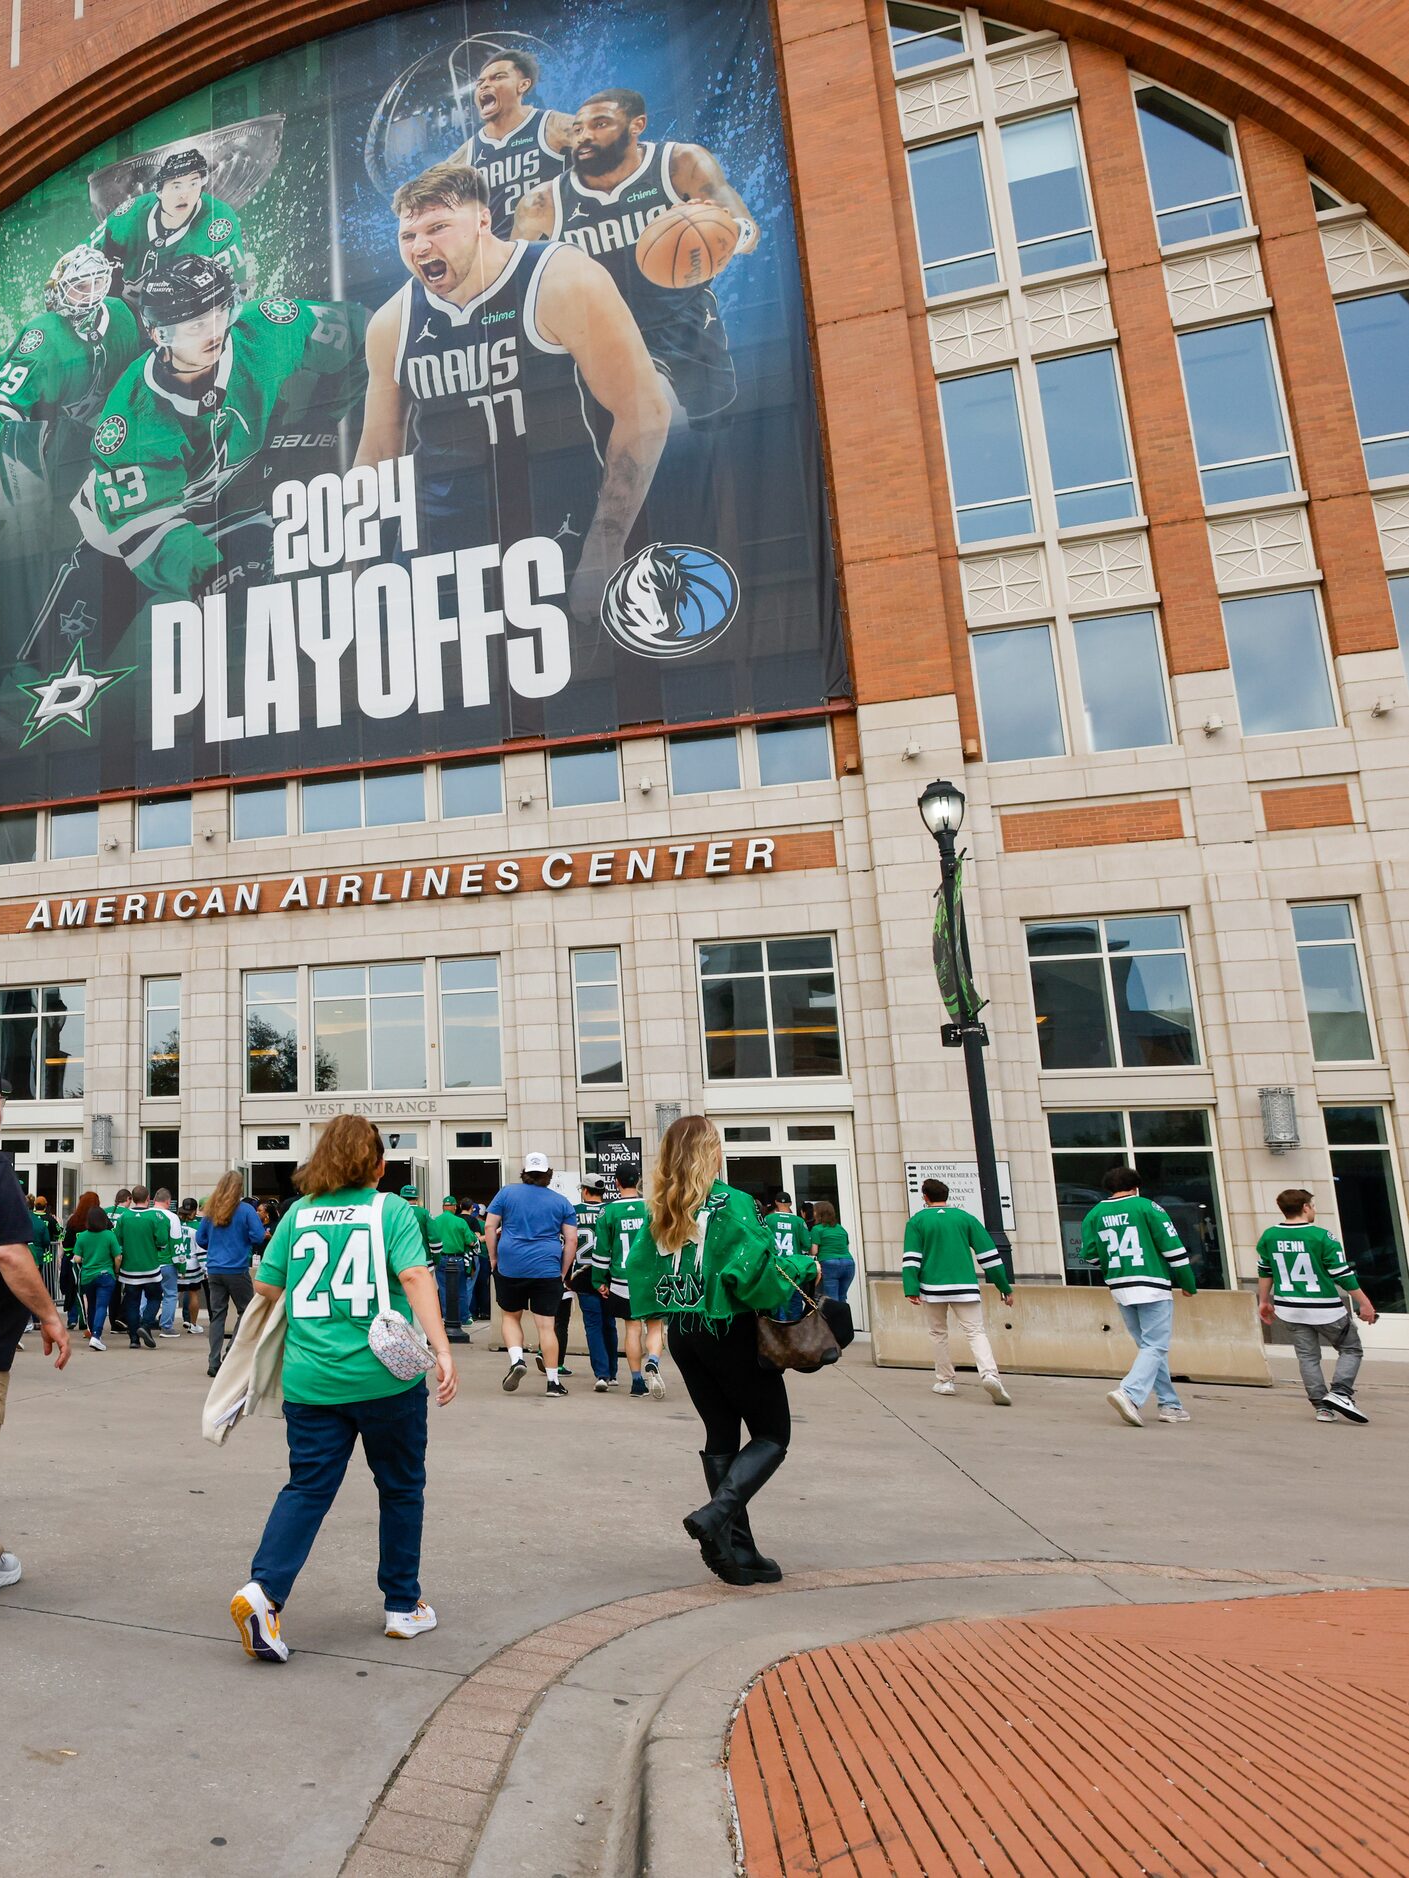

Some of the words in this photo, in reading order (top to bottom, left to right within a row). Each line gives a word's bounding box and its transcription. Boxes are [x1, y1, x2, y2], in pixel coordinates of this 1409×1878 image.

[511, 135, 535, 149] chime
[626, 186, 658, 203] chime
[564, 203, 668, 258] MAV
[481, 308, 516, 325] chime
[407, 336, 519, 400] MAVS
[468, 388, 527, 445] 77
[272, 455, 419, 575] 2024
[151, 535, 573, 751] PLAYOFFS
[26, 882, 262, 931] AMERICAN
[281, 861, 520, 911] AIRLINES
[541, 837, 777, 890] CENTER
[305, 1103, 345, 1116] WEST
[353, 1100, 438, 1115] ENTRANCE
[598, 1153, 611, 1162] NO
[611, 1152, 631, 1162] BAGS
[631, 1152, 640, 1161] IN
[602, 1163, 619, 1172] THIS
[313, 1207, 357, 1223] HINTZ
[1102, 1213, 1130, 1228] HINTZ
[1097, 1226, 1145, 1269] 24
[1277, 1240, 1305, 1253] BENN
[292, 1228, 377, 1320] 24
[1272, 1252, 1321, 1293] 14
